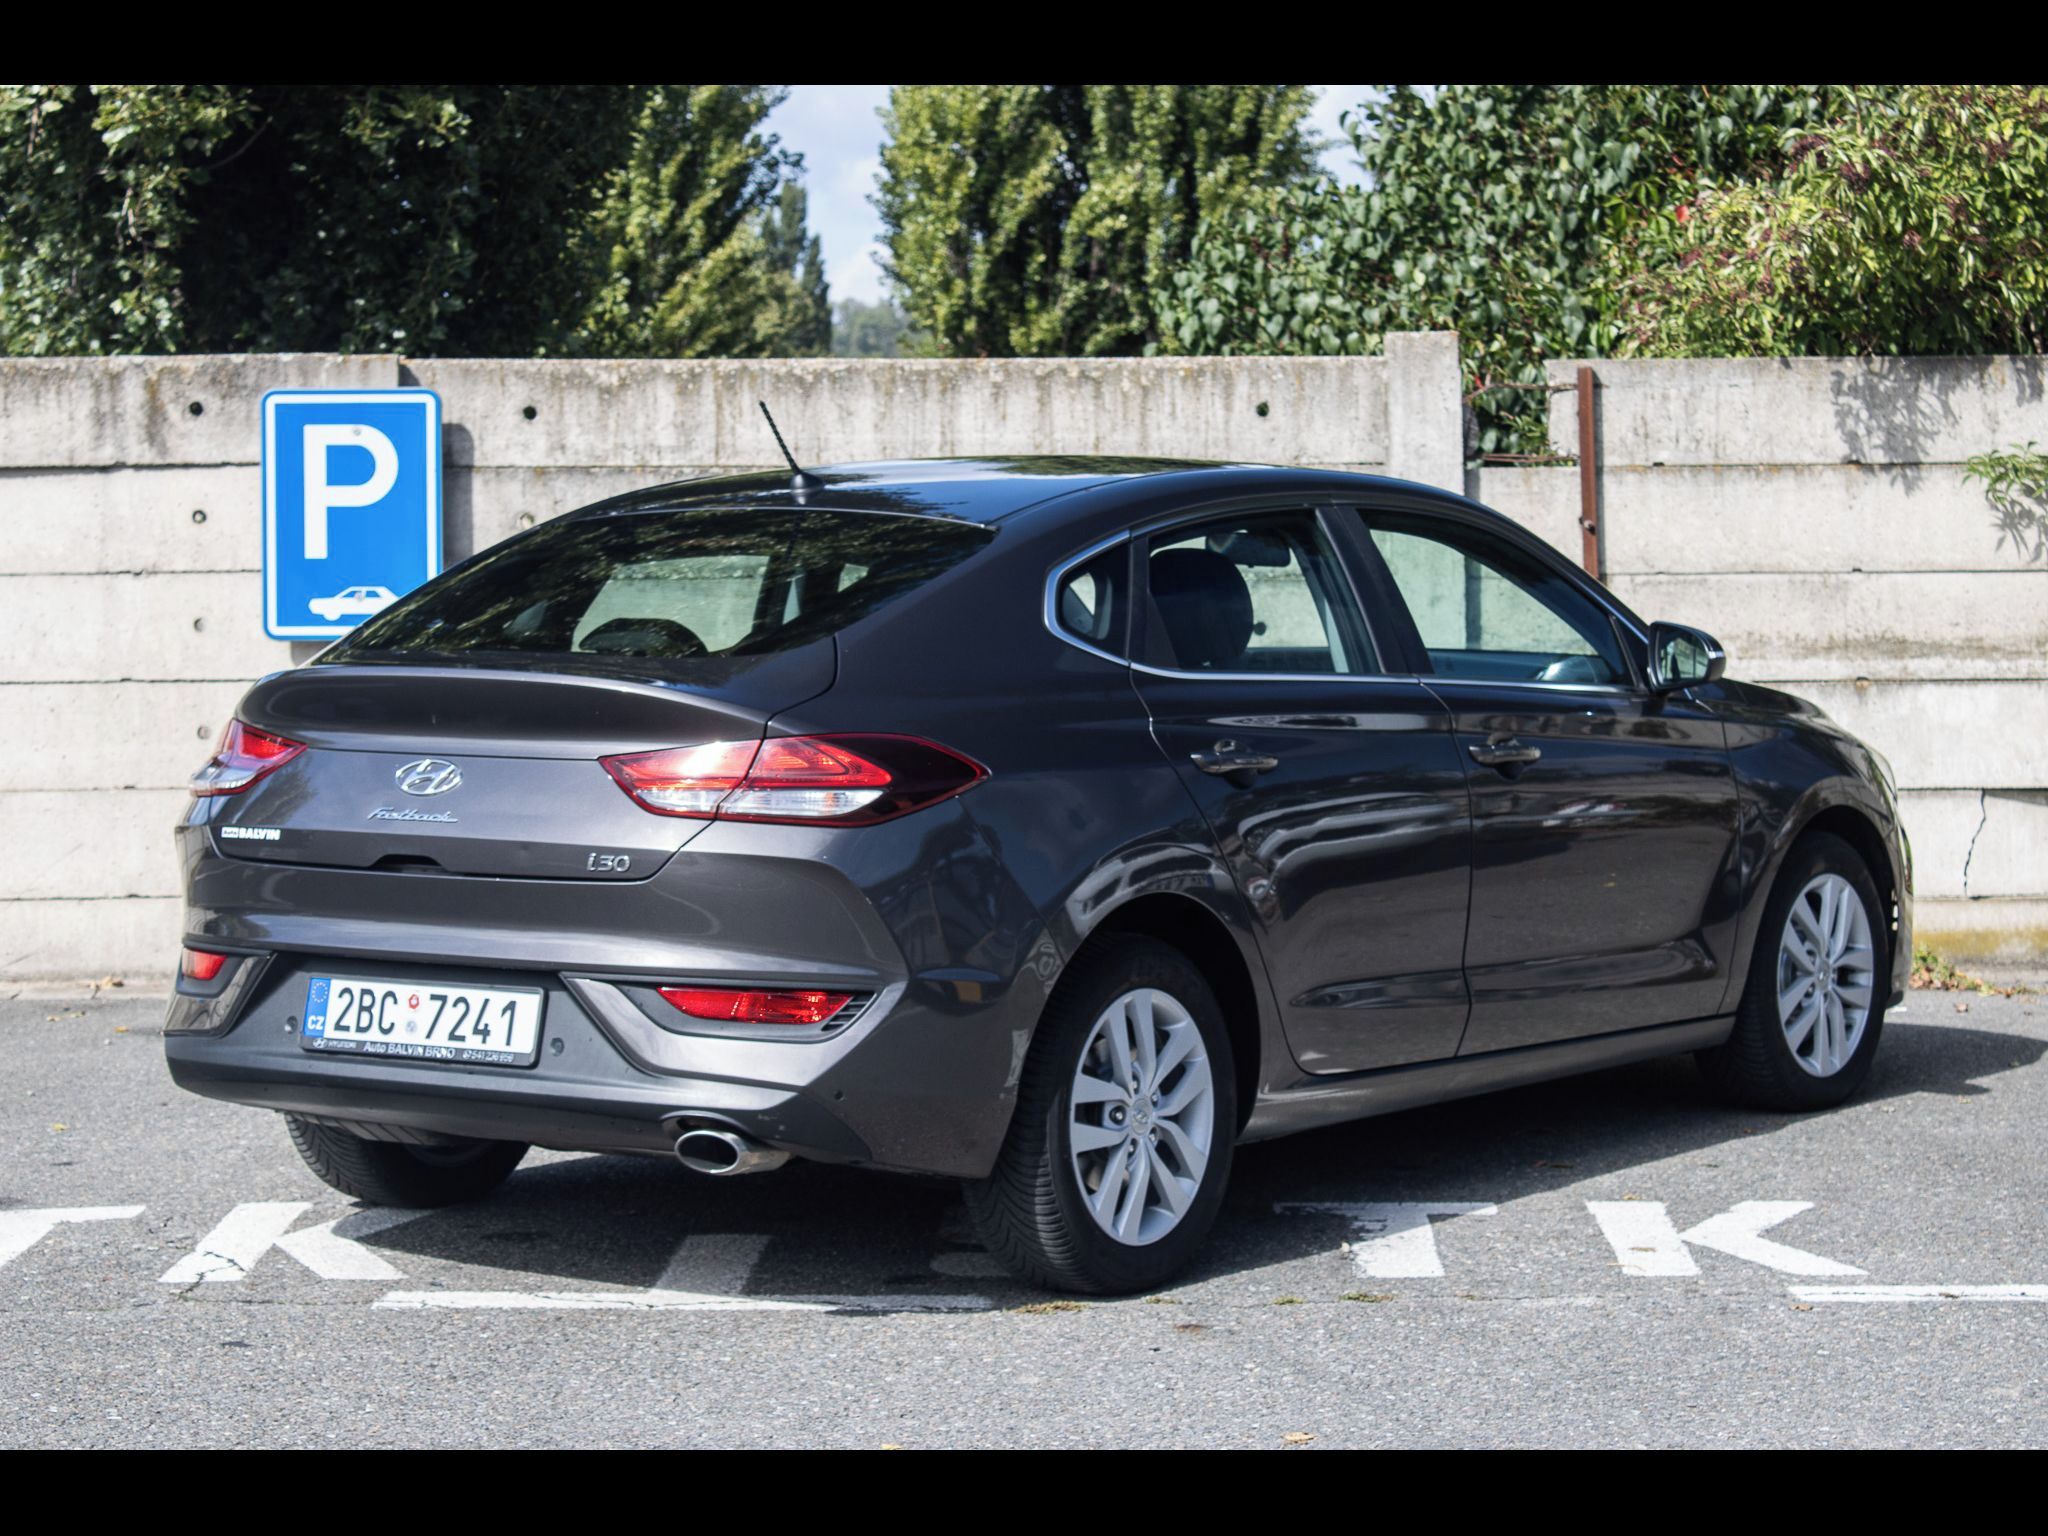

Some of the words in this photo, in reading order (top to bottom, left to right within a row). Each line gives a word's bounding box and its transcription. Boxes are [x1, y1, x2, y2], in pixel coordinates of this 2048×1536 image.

[303, 424, 399, 559] P
[239, 828, 281, 840] BALVIN
[586, 852, 631, 872] i30
[307, 1014, 325, 1031] CZ
[333, 987, 398, 1036] 2BC
[425, 993, 517, 1047] 7241
[363, 1041, 387, 1054] Auto
[387, 1044, 424, 1057] BALVIN
